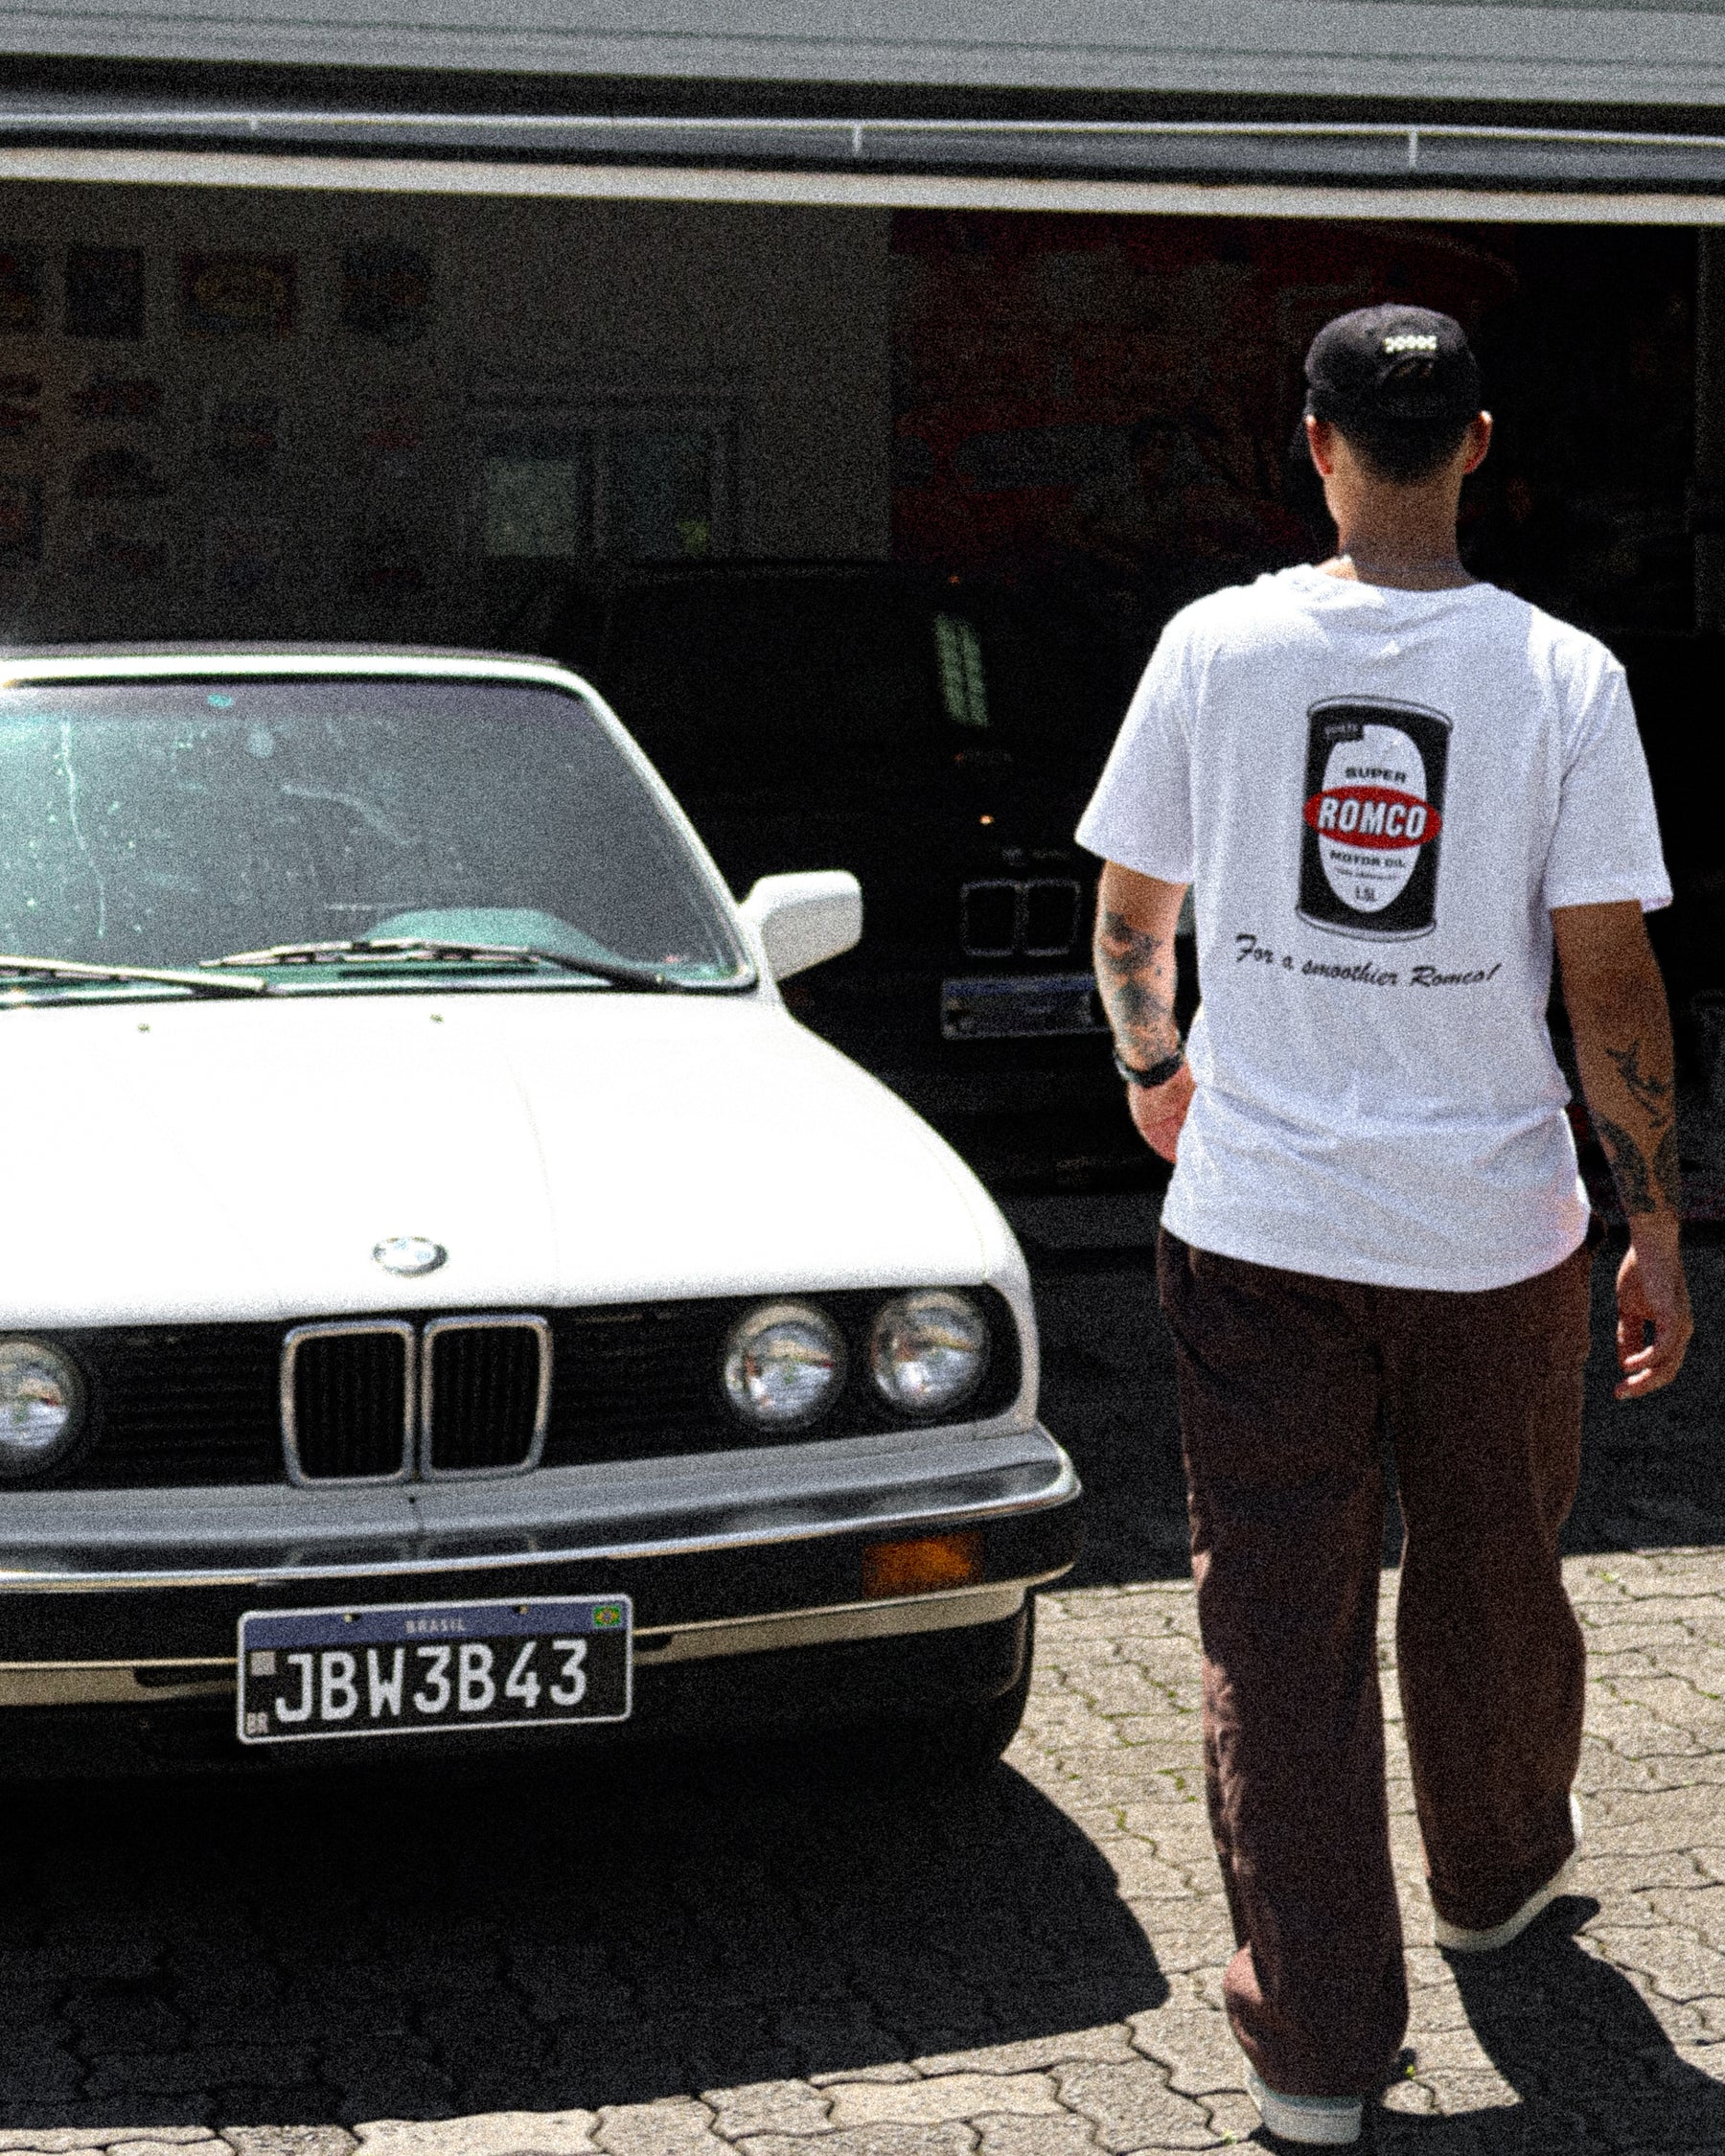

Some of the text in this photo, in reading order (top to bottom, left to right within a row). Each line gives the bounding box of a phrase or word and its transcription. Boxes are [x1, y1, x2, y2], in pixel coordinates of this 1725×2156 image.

[1345, 767, 1407, 784] SUPER
[1317, 796, 1428, 839] ROMCO
[1330, 850, 1406, 868] MOTOR OIL
[1235, 933, 1274, 964] For
[1282, 955, 1295, 972] a
[1301, 959, 1398, 986] smoothier
[405, 1617, 467, 1635] BRASIL
[275, 1639, 587, 1724] JBW3B43
[246, 1711, 268, 1734] BR
